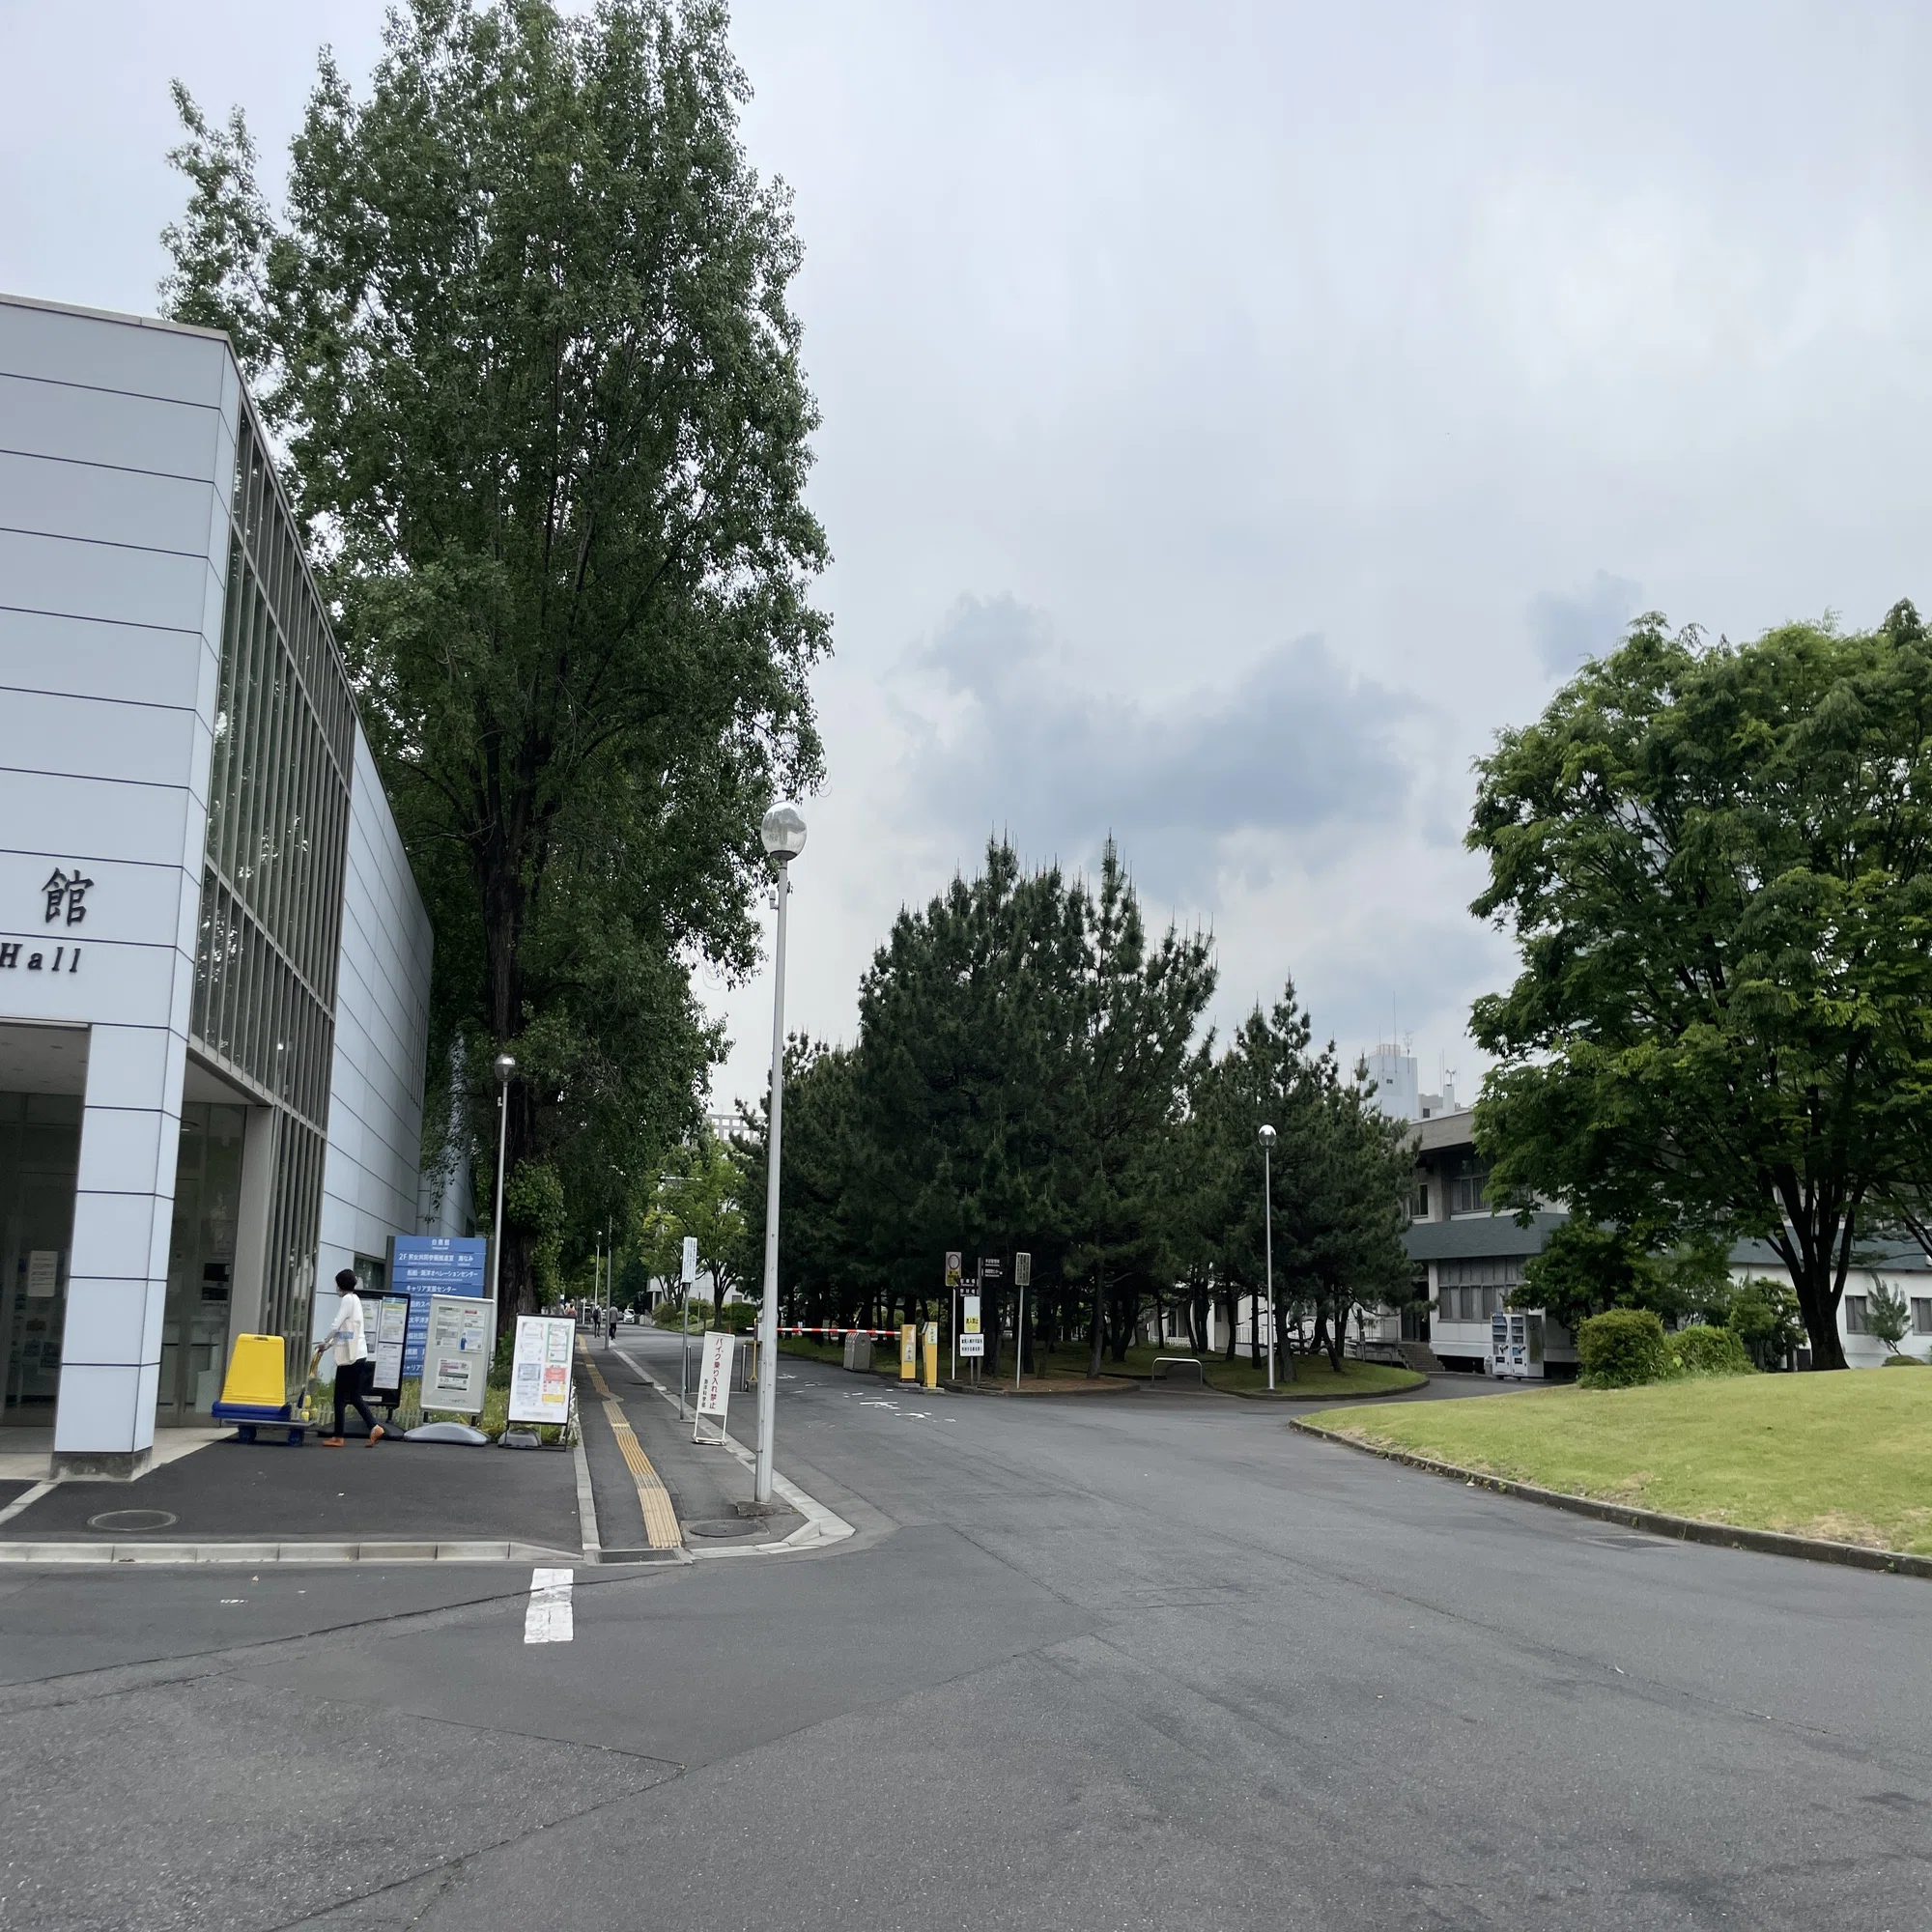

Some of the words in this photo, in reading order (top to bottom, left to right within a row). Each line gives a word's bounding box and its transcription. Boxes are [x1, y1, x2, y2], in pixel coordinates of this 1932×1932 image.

[42, 867, 95, 927] 館
[0, 943, 81, 973] Hall
[709, 1338, 724, 1409] バイク乗り入れ禁止
